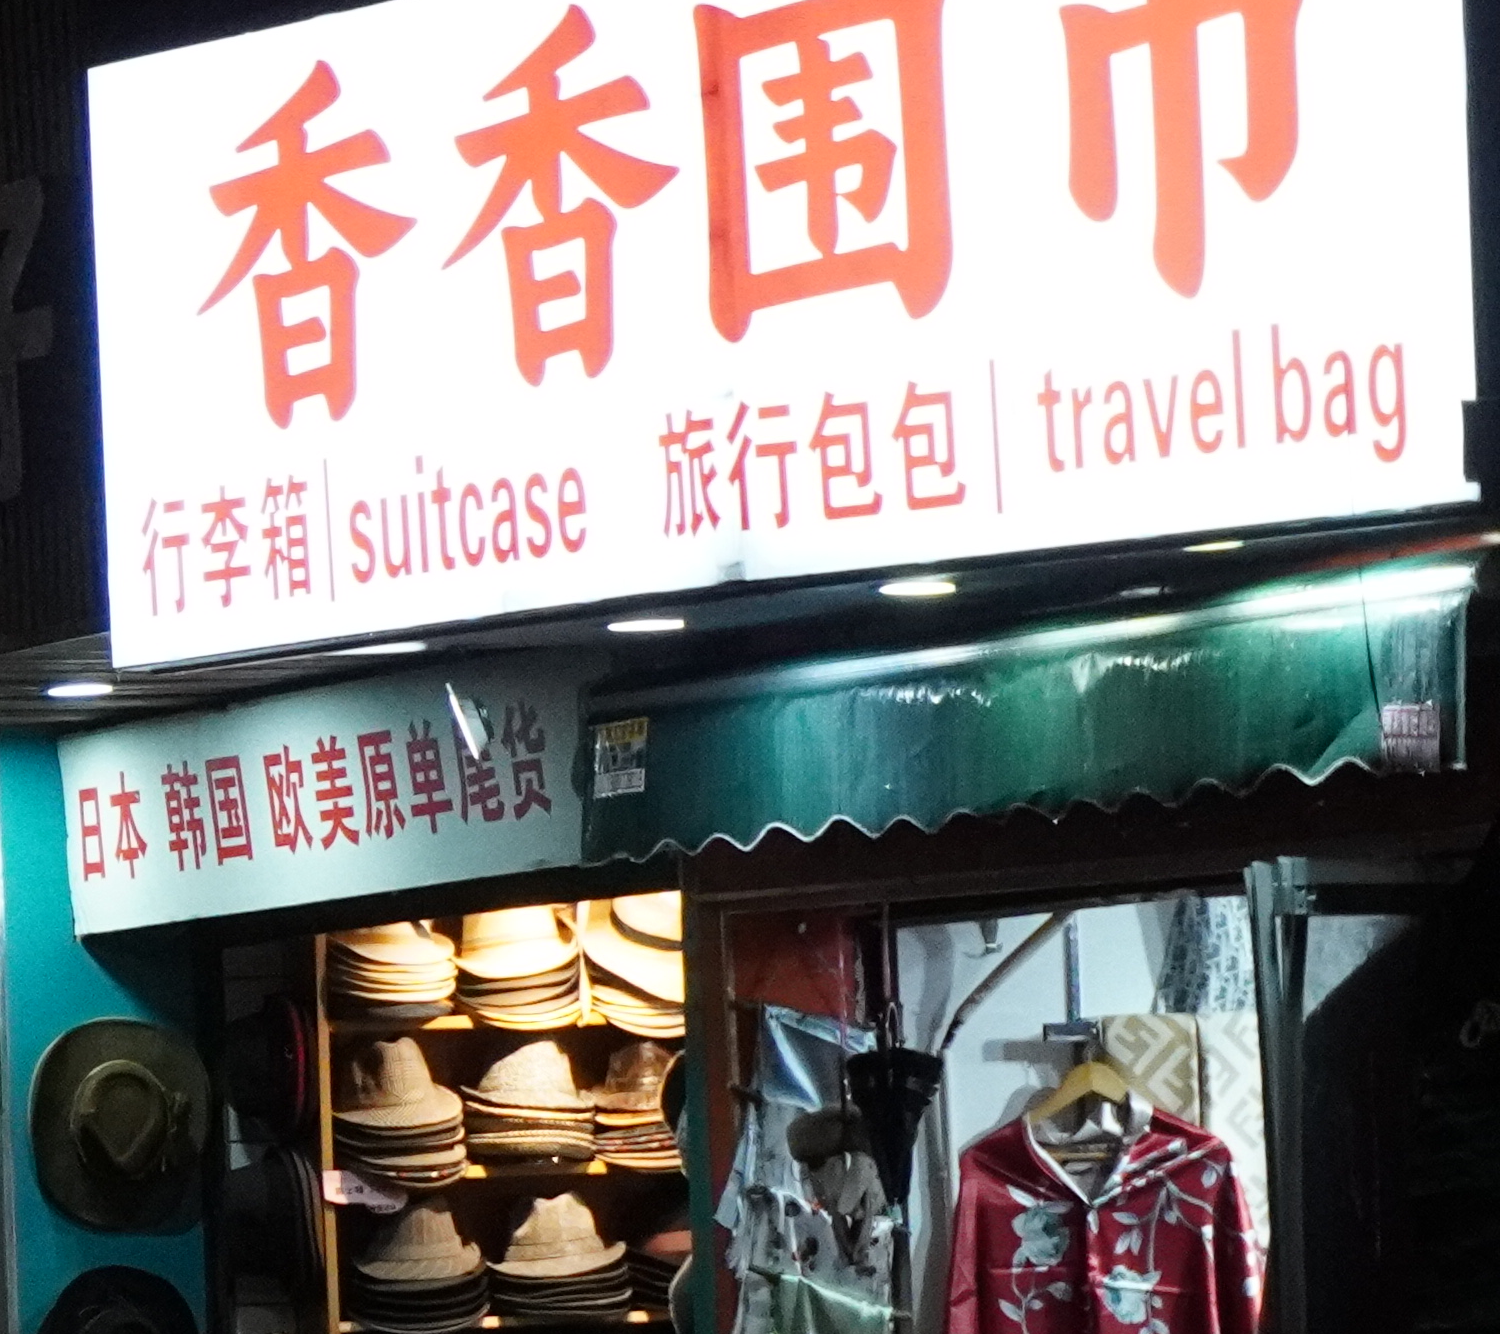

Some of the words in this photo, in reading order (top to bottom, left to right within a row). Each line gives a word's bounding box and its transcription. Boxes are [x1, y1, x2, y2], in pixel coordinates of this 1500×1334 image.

[658, 382, 967, 539] 旅行包包
[1037, 329, 1245, 474] travel
[1273, 322, 1407, 463] bag
[141, 460, 313, 616] 行李箱
[349, 457, 587, 584] suitcase
[78, 770, 148, 880] 日本
[160, 754, 254, 871] 韩国
[263, 702, 553, 855] 欧美原单尾货
